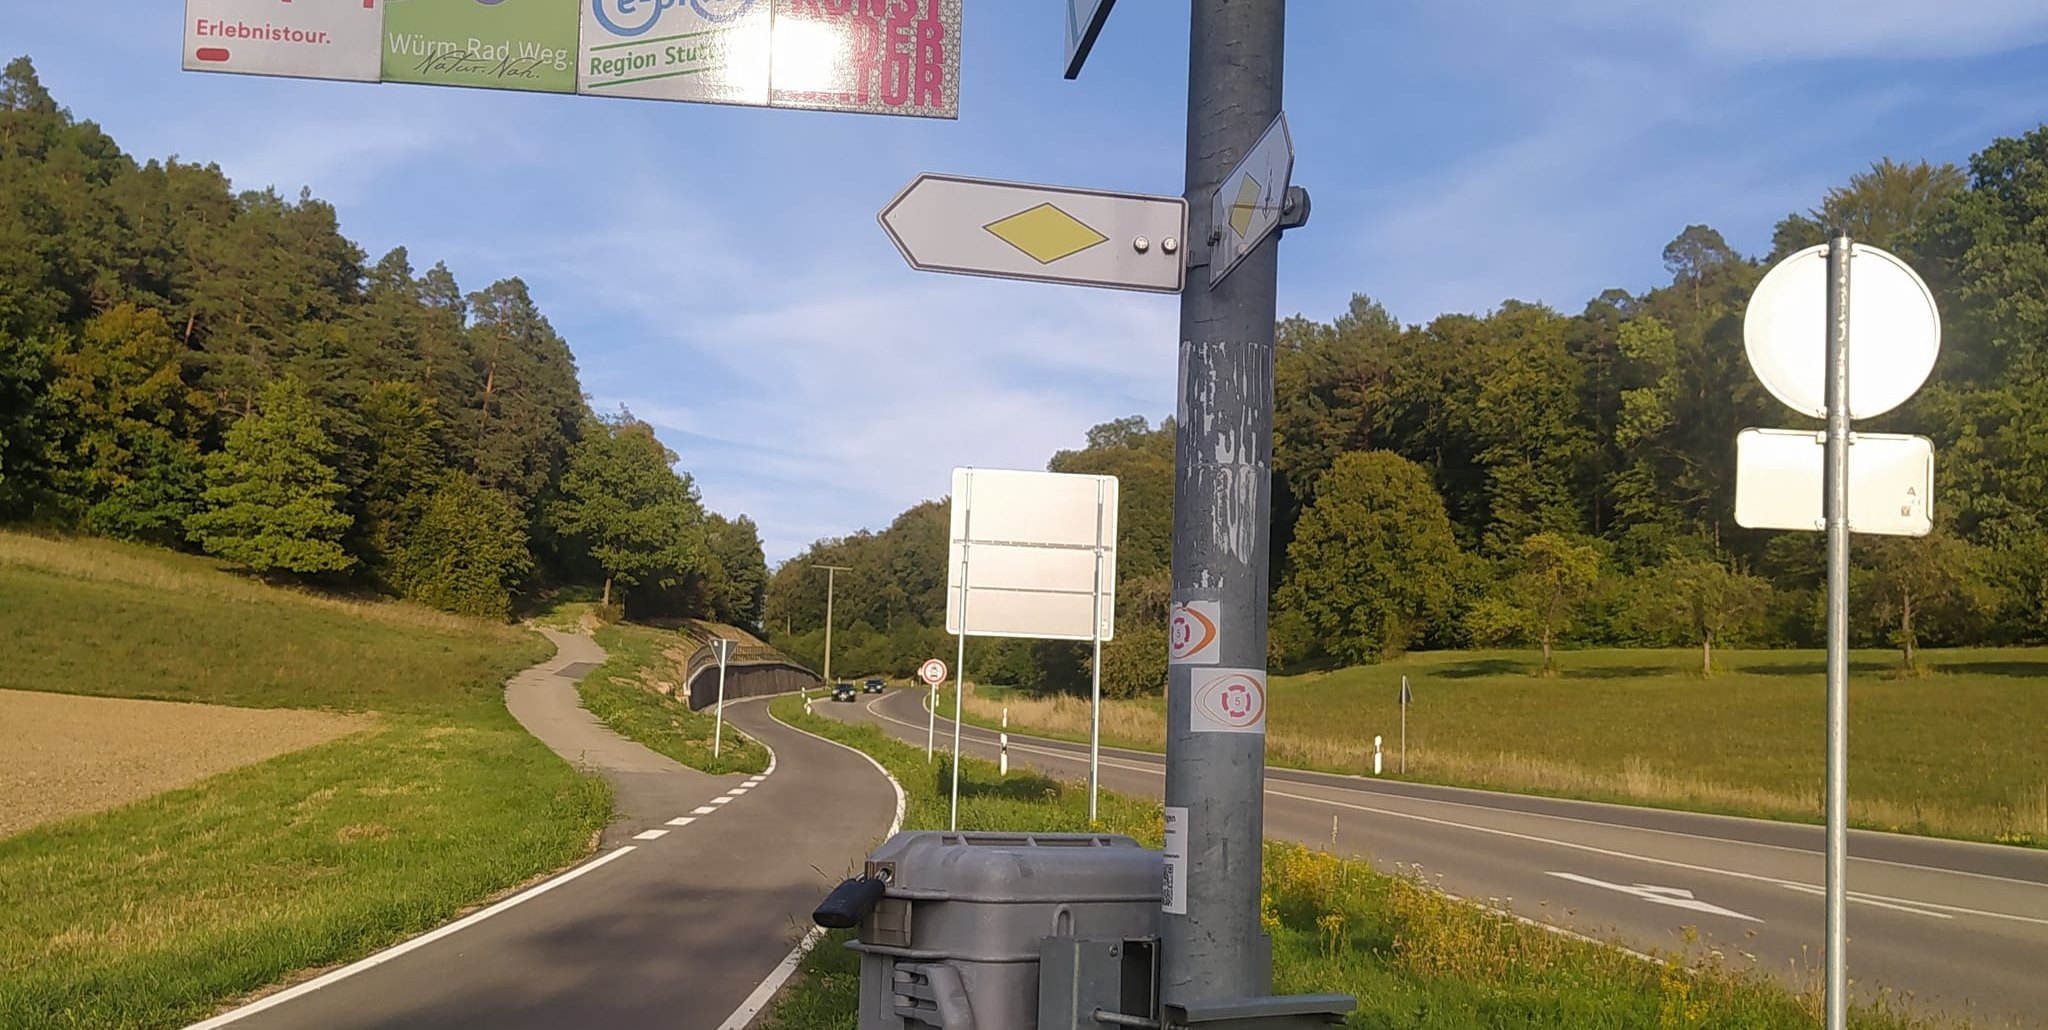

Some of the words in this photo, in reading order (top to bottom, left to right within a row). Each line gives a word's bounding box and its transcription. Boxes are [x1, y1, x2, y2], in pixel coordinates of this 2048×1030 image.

[196, 19, 331, 44] Erlebnistour.
[590, 52, 657, 77] Region
[1175, 627, 1181, 638] 5
[1234, 697, 1241, 706] 5
